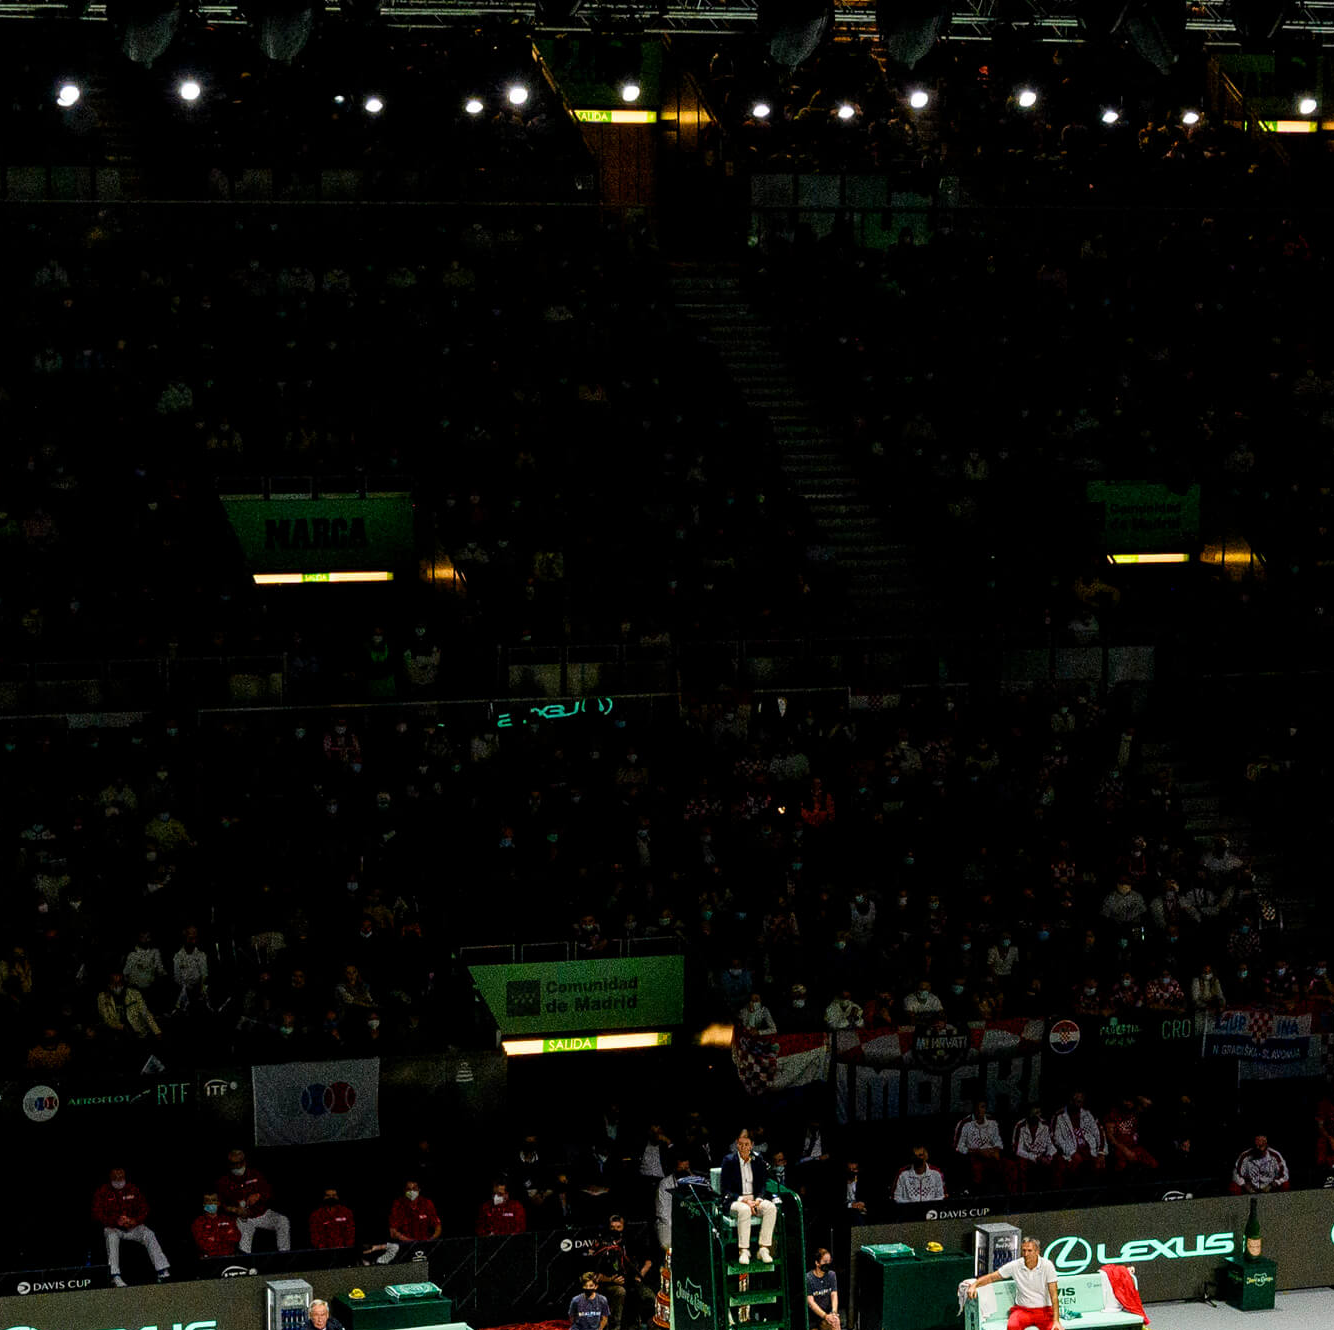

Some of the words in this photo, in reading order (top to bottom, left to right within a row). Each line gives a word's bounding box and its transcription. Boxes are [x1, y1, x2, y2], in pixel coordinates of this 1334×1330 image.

[265, 518, 368, 548] MARCA
[546, 976, 638, 994] Comunidad
[546, 1000, 567, 1013] de
[575, 996, 637, 1012] Madrid
[548, 1038, 592, 1050] SALIDA
[157, 1083, 187, 1105] RTF
[206, 1085, 228, 1097] ITF
[939, 1209, 967, 1220] DAVIS
[969, 1207, 991, 1217] CUP
[1097, 1232, 1234, 1264] LEXUS
[32, 1280, 66, 1292] DAVIS
[68, 1278, 91, 1289] CUP
